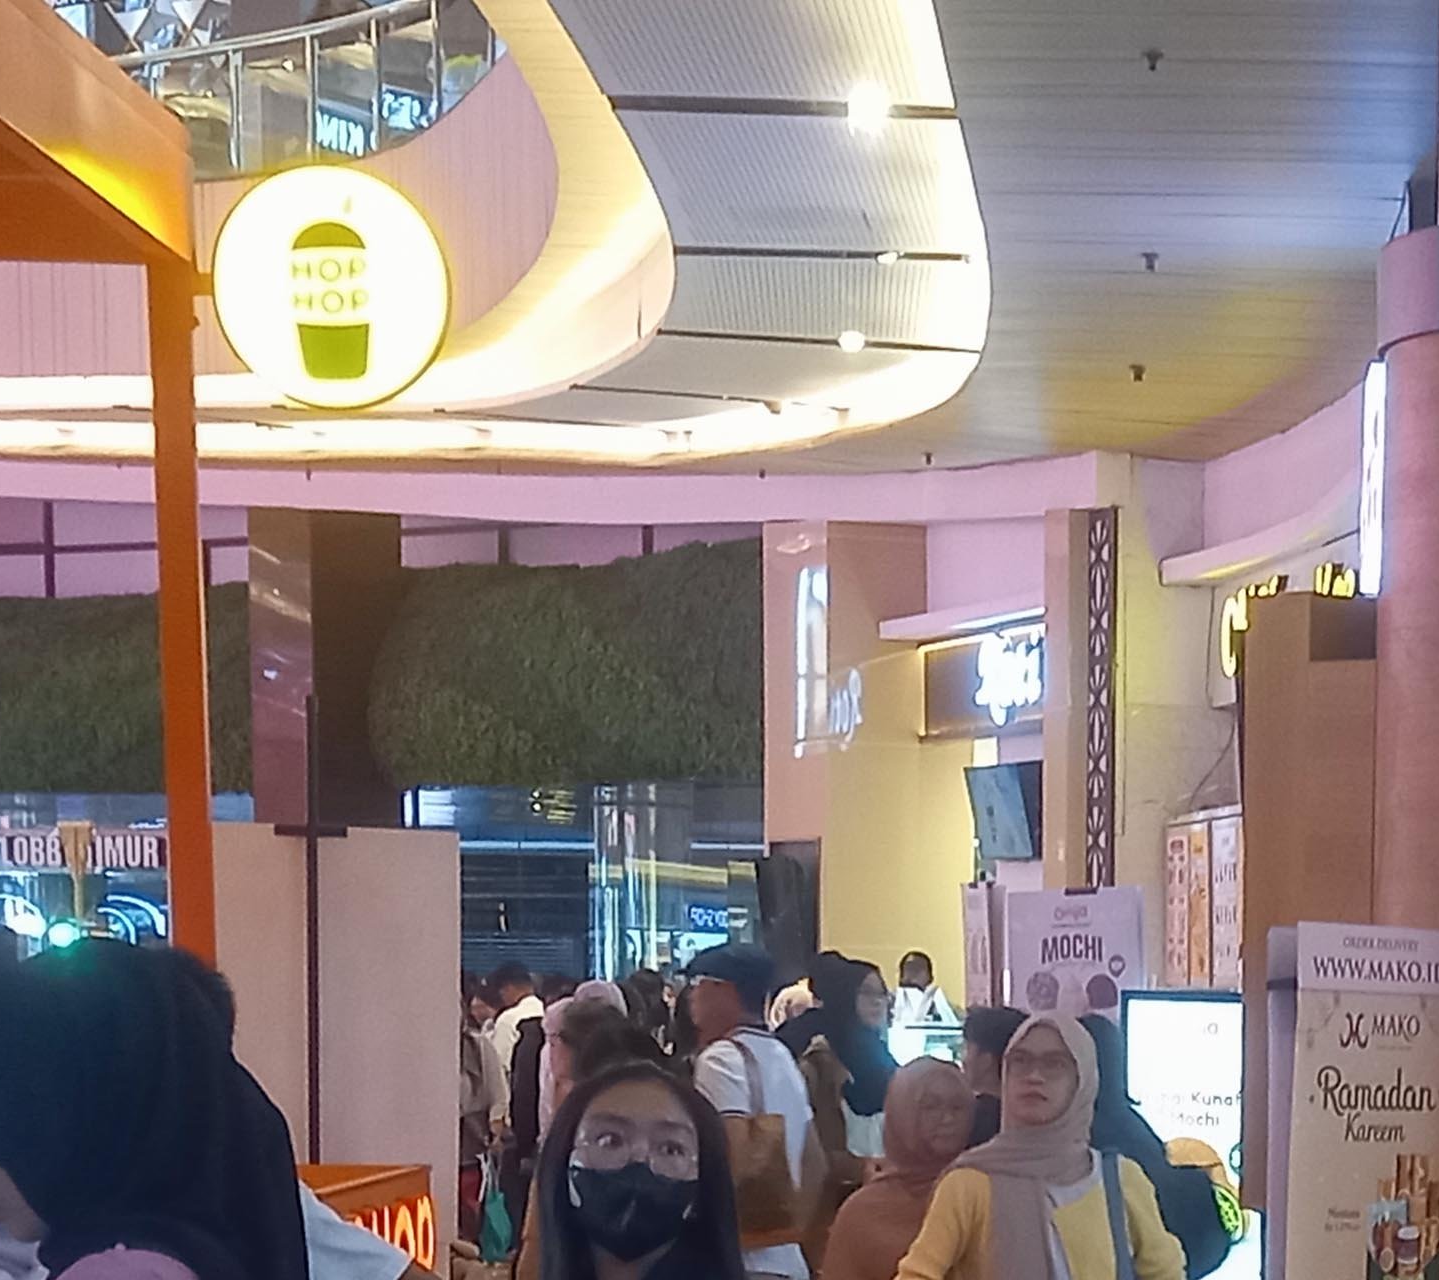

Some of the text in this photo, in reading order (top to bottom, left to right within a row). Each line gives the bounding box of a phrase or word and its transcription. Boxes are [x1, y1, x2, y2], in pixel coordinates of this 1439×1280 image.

[291, 257, 366, 282] HOP
[293, 288, 369, 313] HOP
[1, 835, 62, 867] LOBB
[1041, 934, 1103, 964] MOCHI
[1343, 936, 1375, 950] ORDER
[1371, 1013, 1421, 1042] MAKO
[1317, 1065, 1437, 1116] Ramadan
[1344, 1110, 1406, 1142] Kareem
